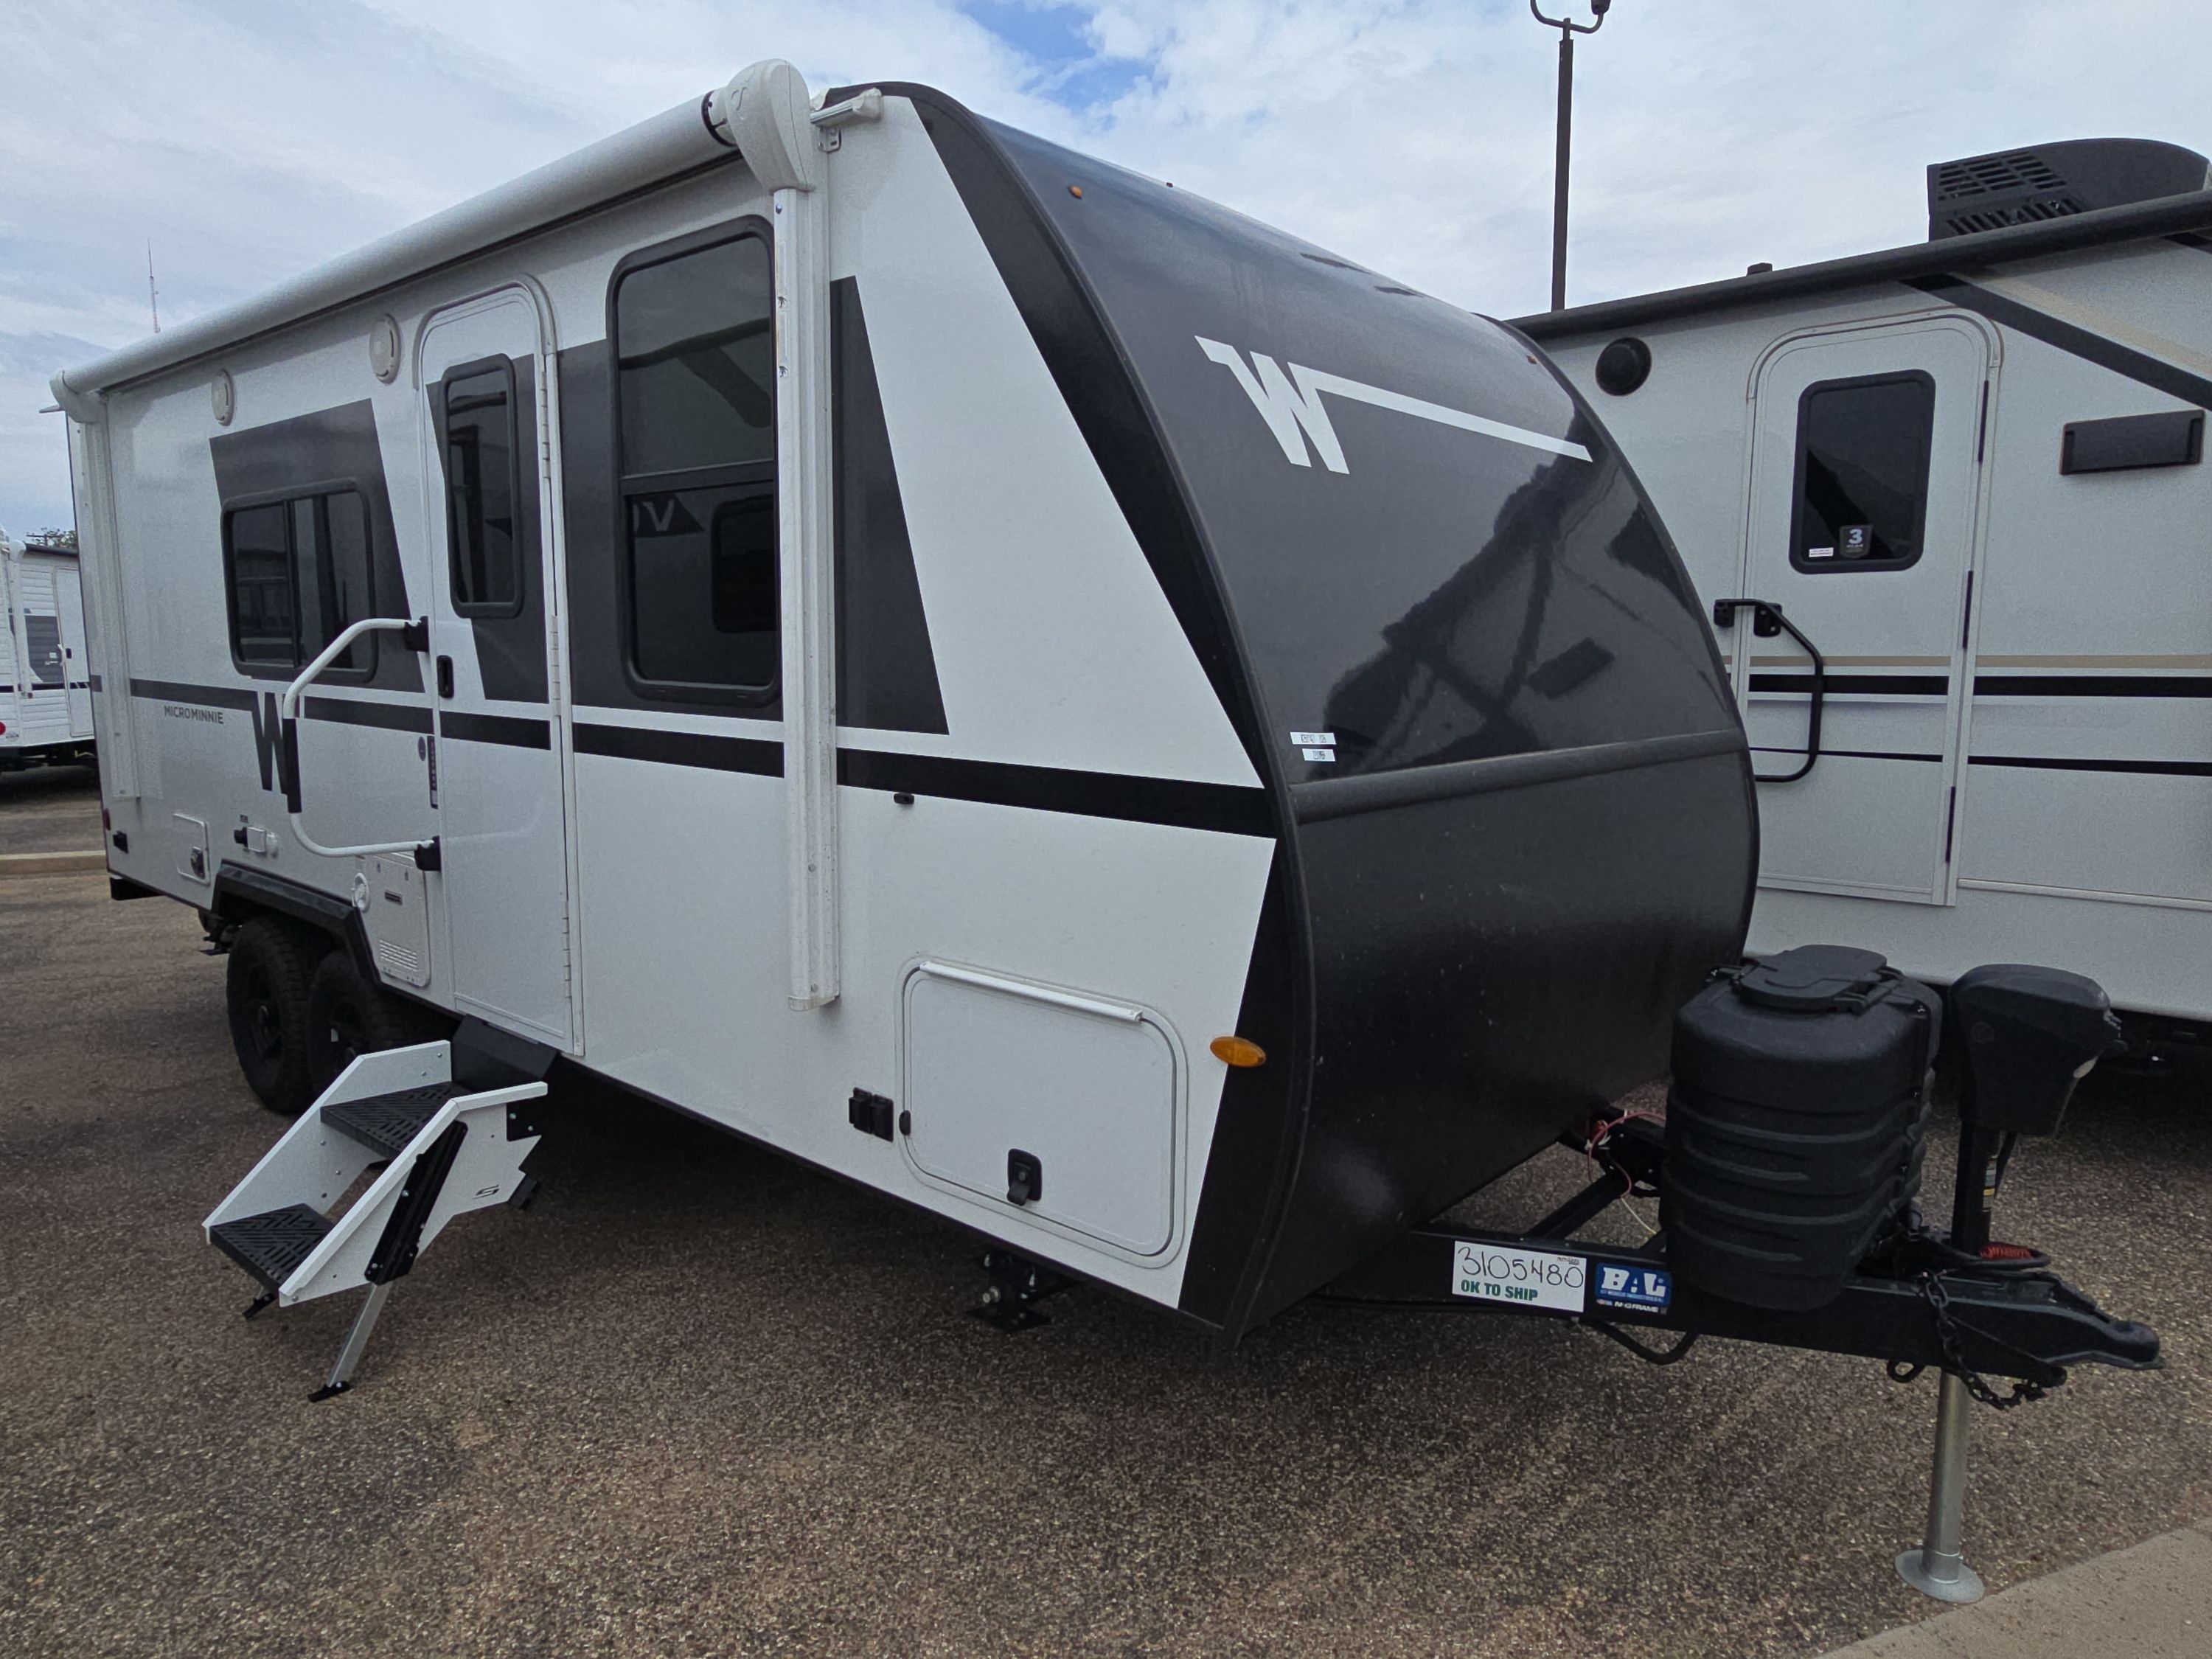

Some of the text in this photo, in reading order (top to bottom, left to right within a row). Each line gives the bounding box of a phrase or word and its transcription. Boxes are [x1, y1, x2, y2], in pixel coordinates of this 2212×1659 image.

[1848, 528, 1863, 544] 3
[1458, 1246, 1584, 1288] 3105480
[1461, 1279, 1539, 1301] OK TO SHIP
[1601, 1267, 1666, 1298] BAL
